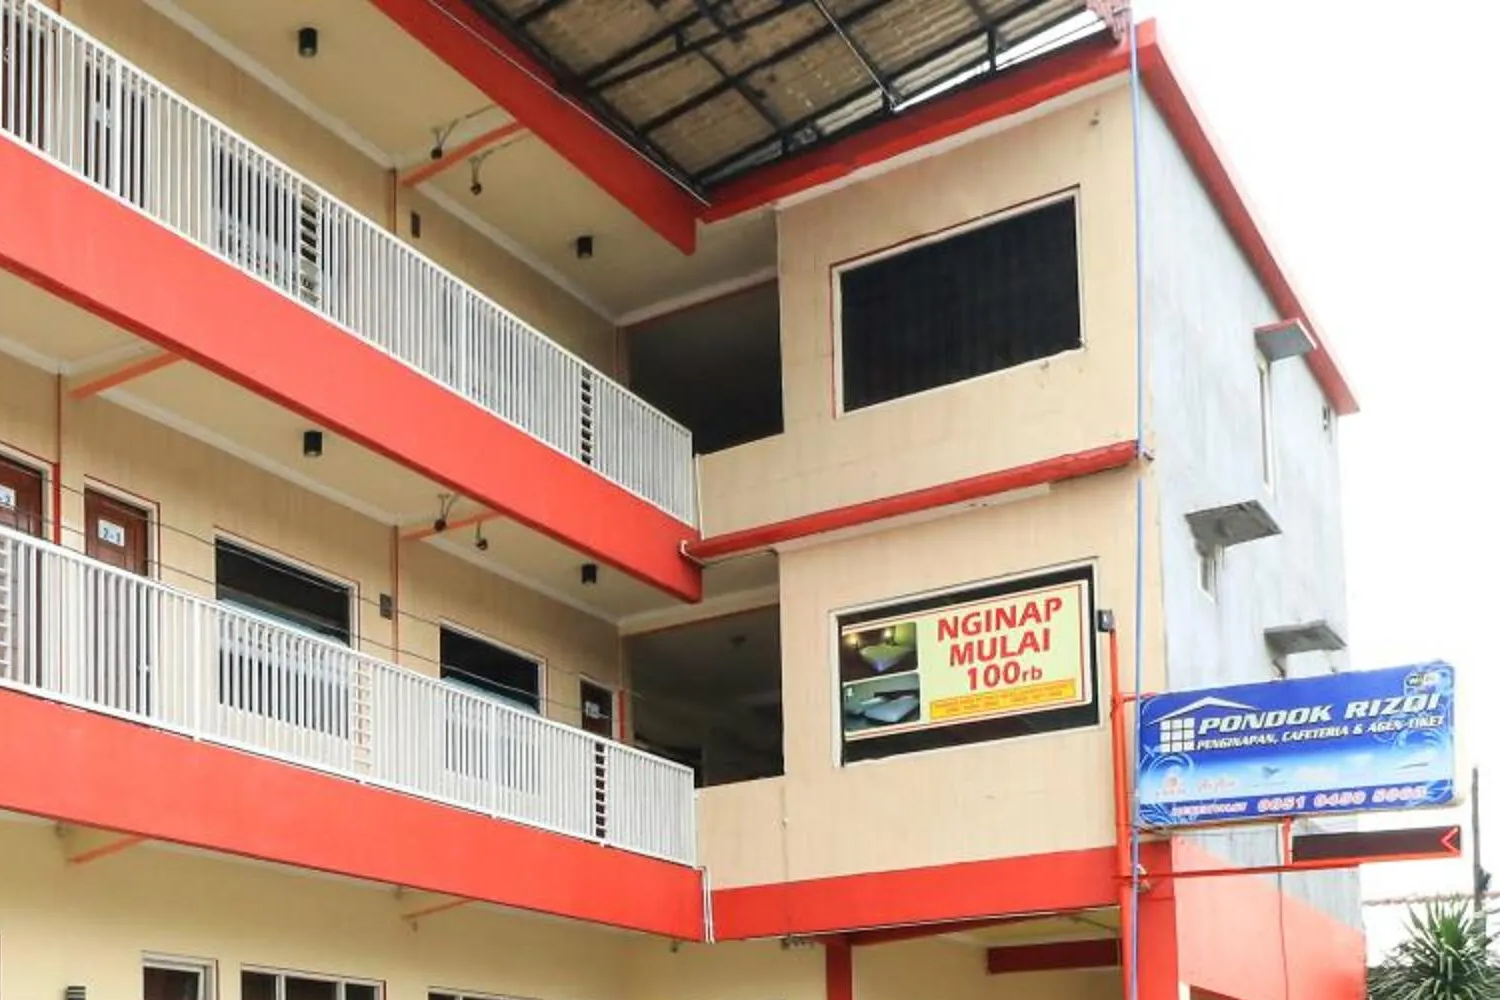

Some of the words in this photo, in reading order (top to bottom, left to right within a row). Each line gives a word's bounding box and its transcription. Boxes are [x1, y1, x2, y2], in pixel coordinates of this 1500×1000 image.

[937, 597, 1063, 643] NGINAP
[949, 627, 1051, 668] MULAI
[967, 661, 1043, 690] 100rb
[1198, 703, 1333, 735] PONDOK
[1281, 726, 1349, 743] CAFETERIA
[1352, 723, 1364, 735] &
